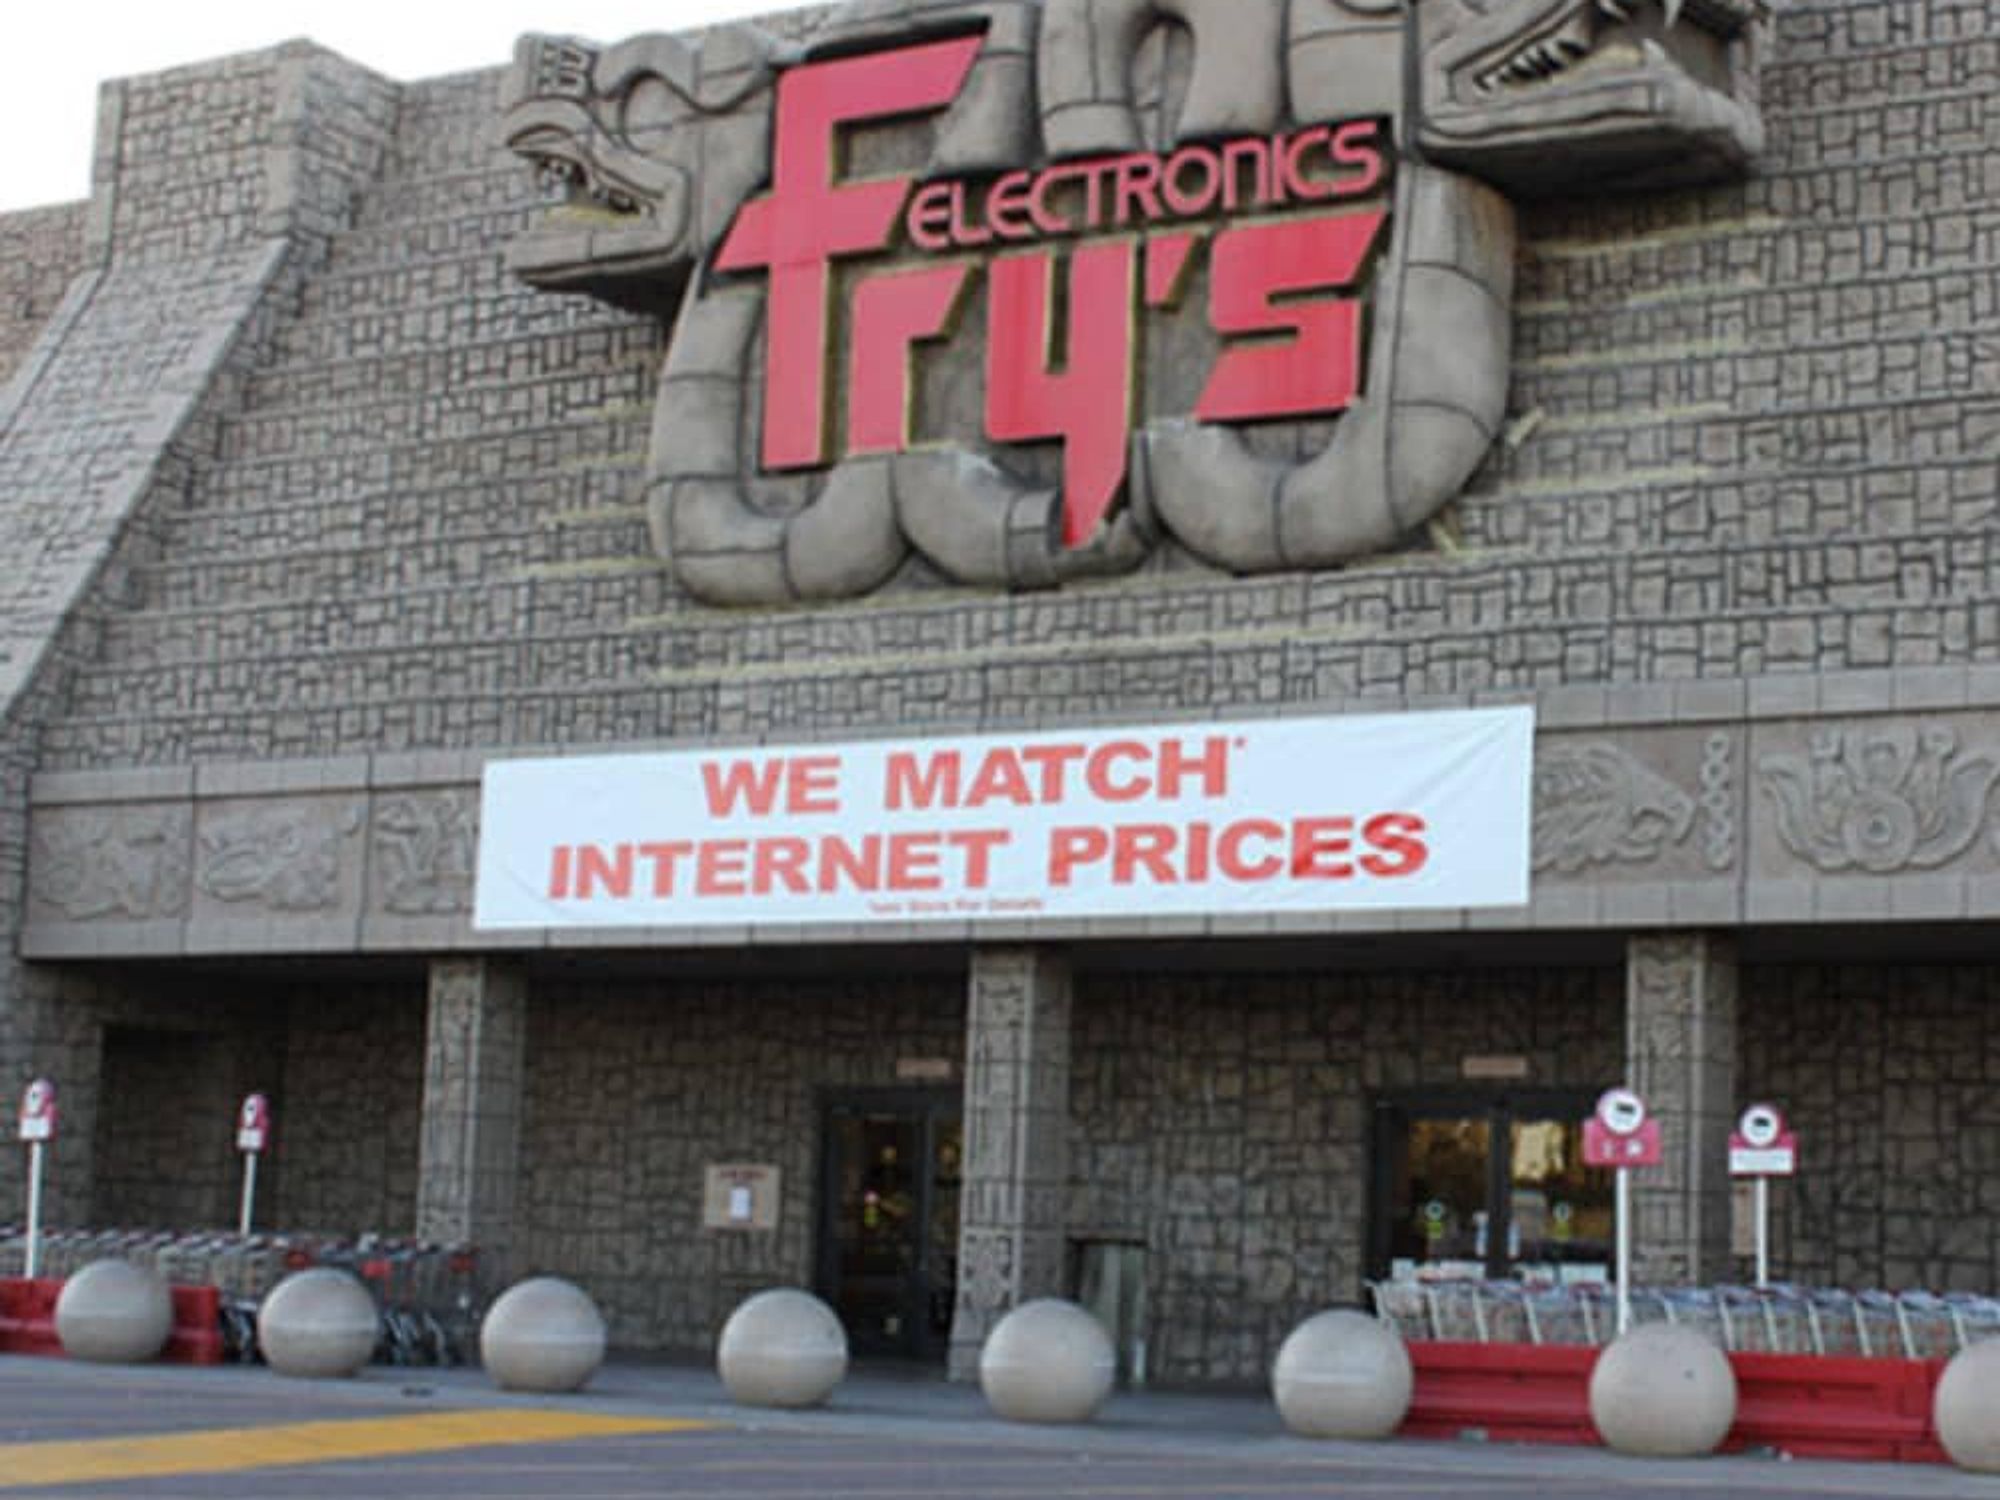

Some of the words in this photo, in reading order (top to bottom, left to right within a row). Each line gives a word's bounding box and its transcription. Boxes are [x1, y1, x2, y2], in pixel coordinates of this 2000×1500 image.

[907, 120, 1381, 248] ELECTRONICS
[702, 757, 841, 817] WE
[549, 829, 1010, 898] INTERNET
[1047, 812, 1429, 885] PRICES
